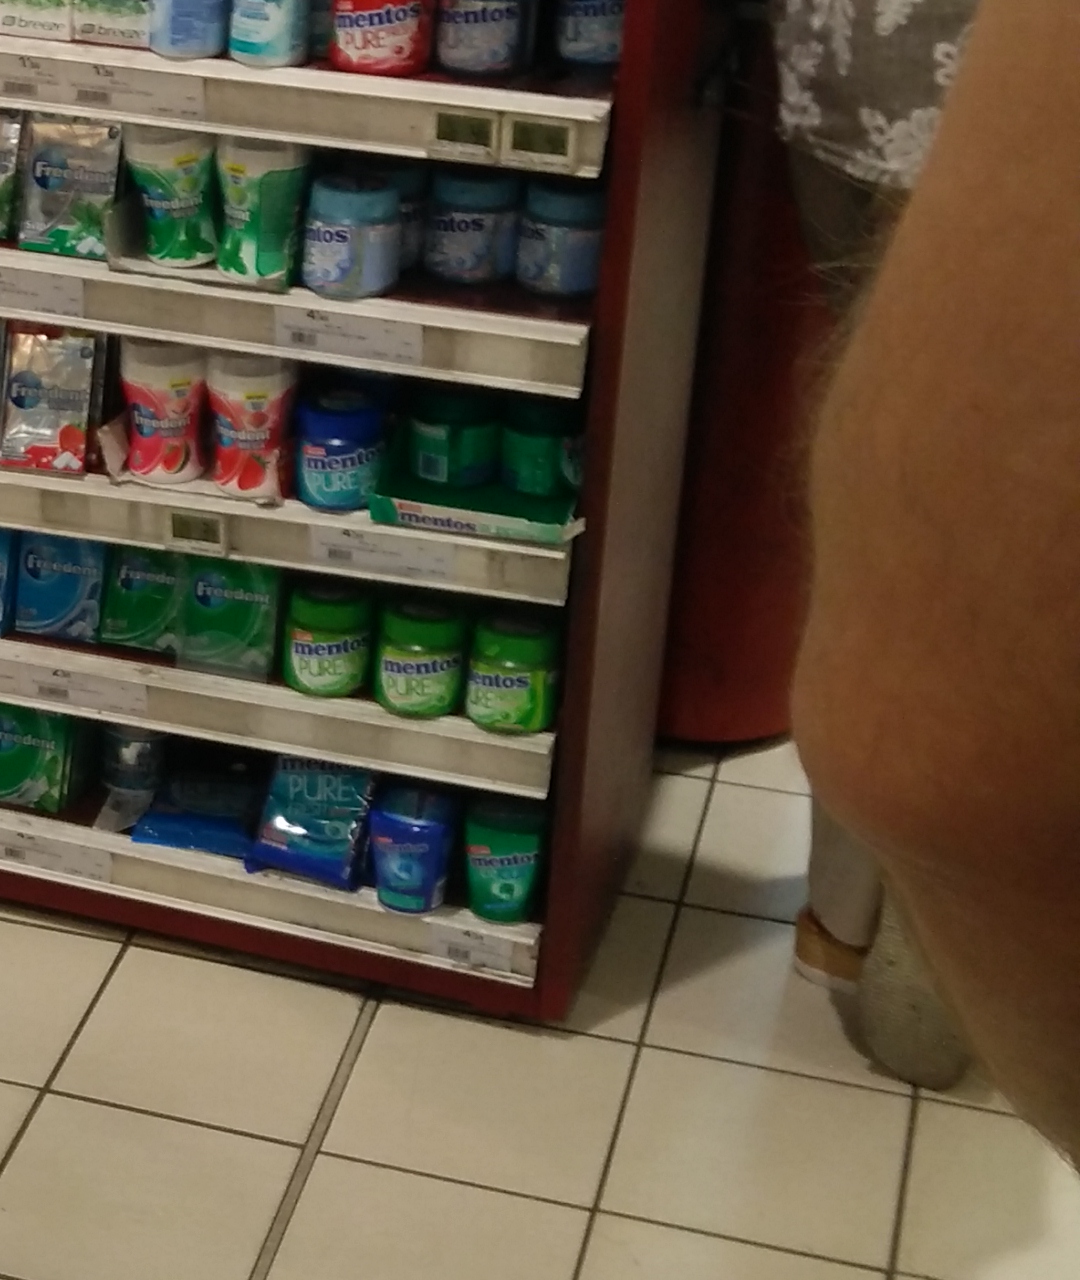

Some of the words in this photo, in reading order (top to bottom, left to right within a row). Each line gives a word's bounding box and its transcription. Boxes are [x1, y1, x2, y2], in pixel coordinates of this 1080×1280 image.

[336, 1, 420, 30] mentos
[400, 511, 477, 533] mentos
[294, 636, 368, 657] mentos
[384, 655, 461, 676] mentos
[288, 775, 353, 802] PURE
